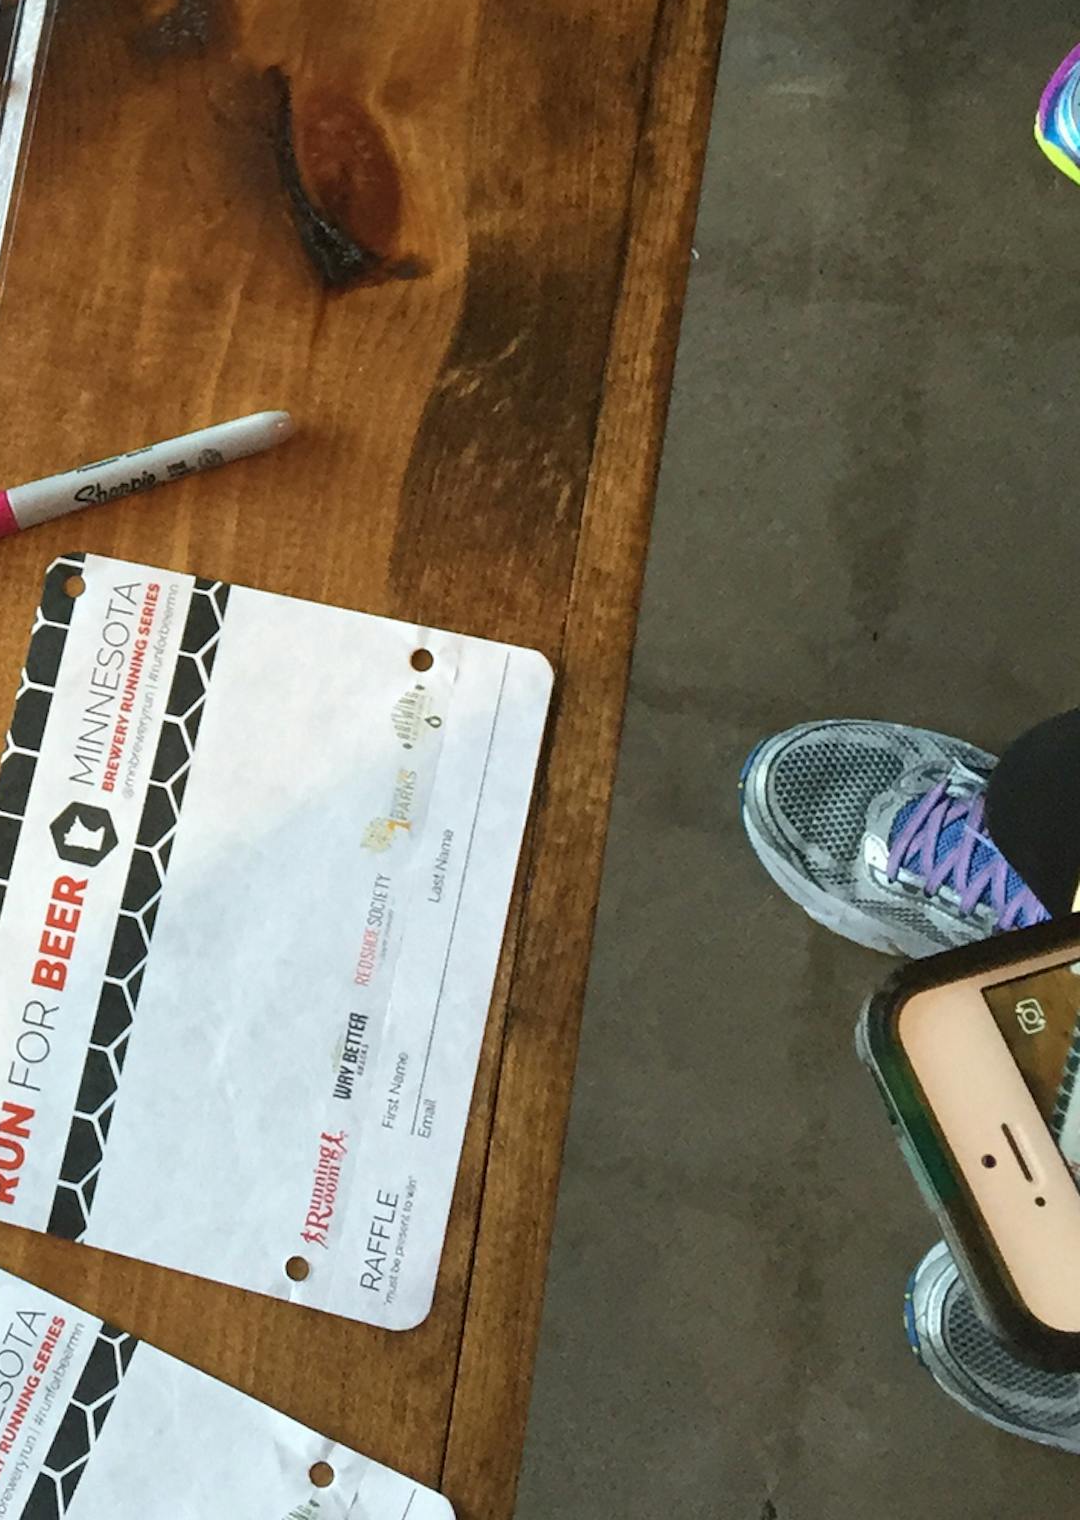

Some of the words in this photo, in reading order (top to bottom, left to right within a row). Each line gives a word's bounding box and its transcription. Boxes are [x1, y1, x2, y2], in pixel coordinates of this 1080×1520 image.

[69, 582, 142, 786] MINNESOTA
[102, 718, 129, 792] BREWERY
[121, 641, 147, 713] RUNNING
[144, 583, 160, 637] SERIES
[398, 771, 418, 821] PARKS
[435, 829, 454, 872] Name
[367, 873, 391, 927] SOCIETY
[428, 872, 444, 903] Last
[31, 875, 88, 992] BEER
[8, 1000, 59, 1091] FOR
[343, 1012, 369, 1065] BETTER
[333, 1065, 355, 1100] WAY
[390, 1051, 408, 1095] Name
[382, 1094, 400, 1130] First
[418, 1099, 437, 1139] Email
[360, 1189, 399, 1292] RAFFLE
[32, 1315, 66, 1374] SERIES
[34, 1322, 85, 1428] #runforbeermn
